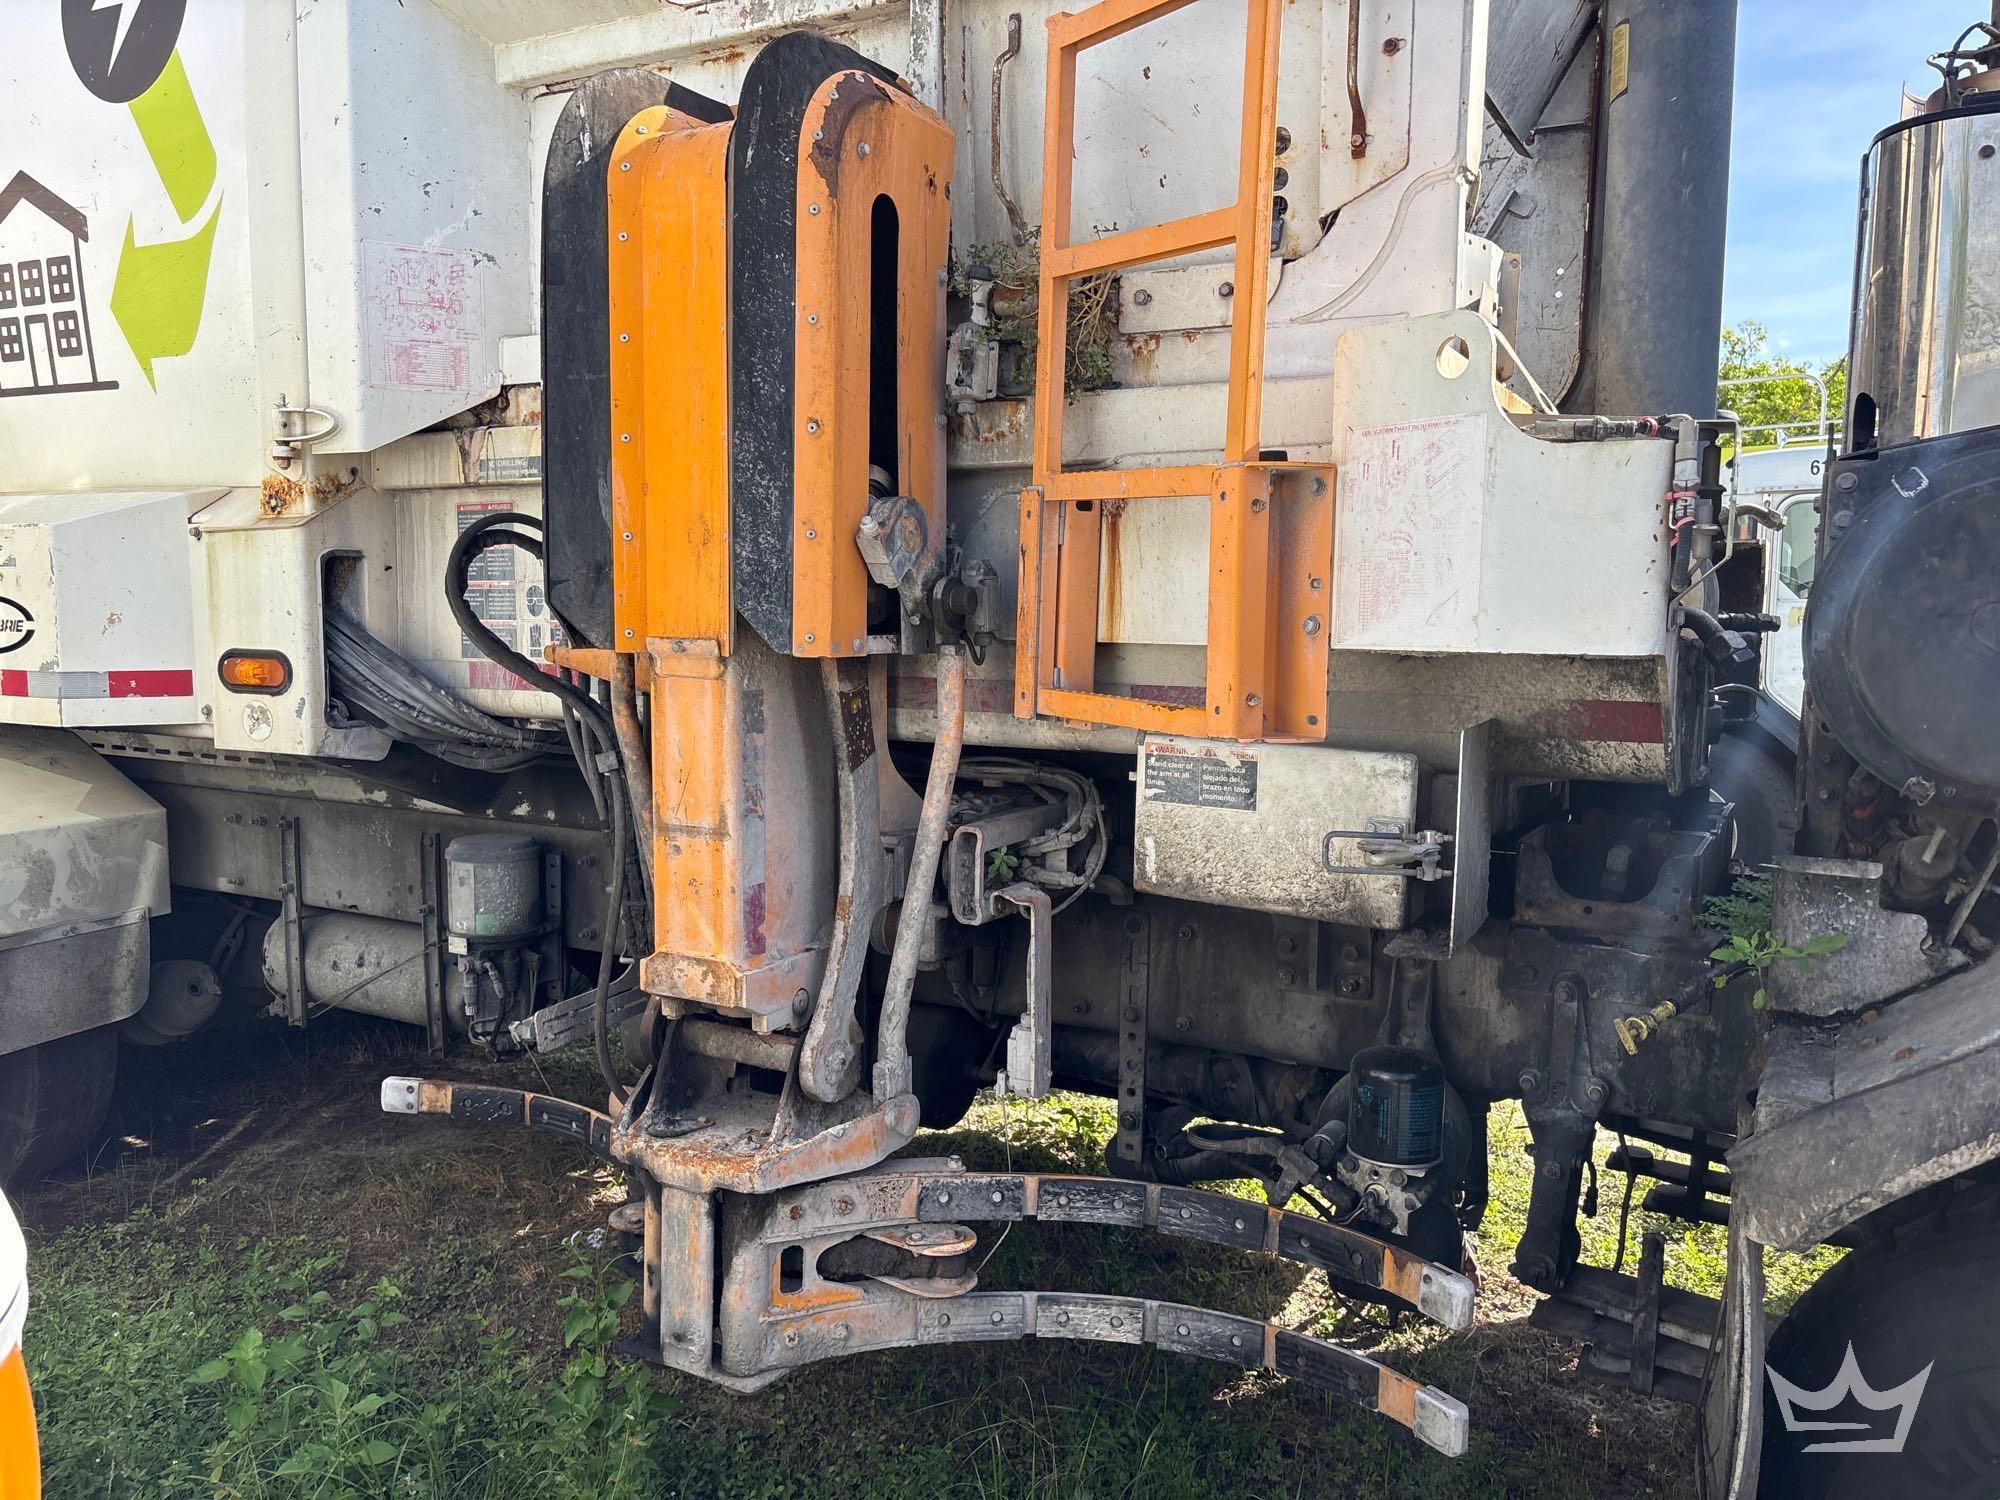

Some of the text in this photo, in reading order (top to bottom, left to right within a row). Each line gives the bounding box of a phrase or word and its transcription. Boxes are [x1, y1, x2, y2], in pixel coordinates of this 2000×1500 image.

[1157, 746, 1196, 756] WARNIN
[1147, 758, 1194, 770] Stand clear of
[1202, 774, 1228, 783] alejado
[1202, 783, 1222, 791] brazo
